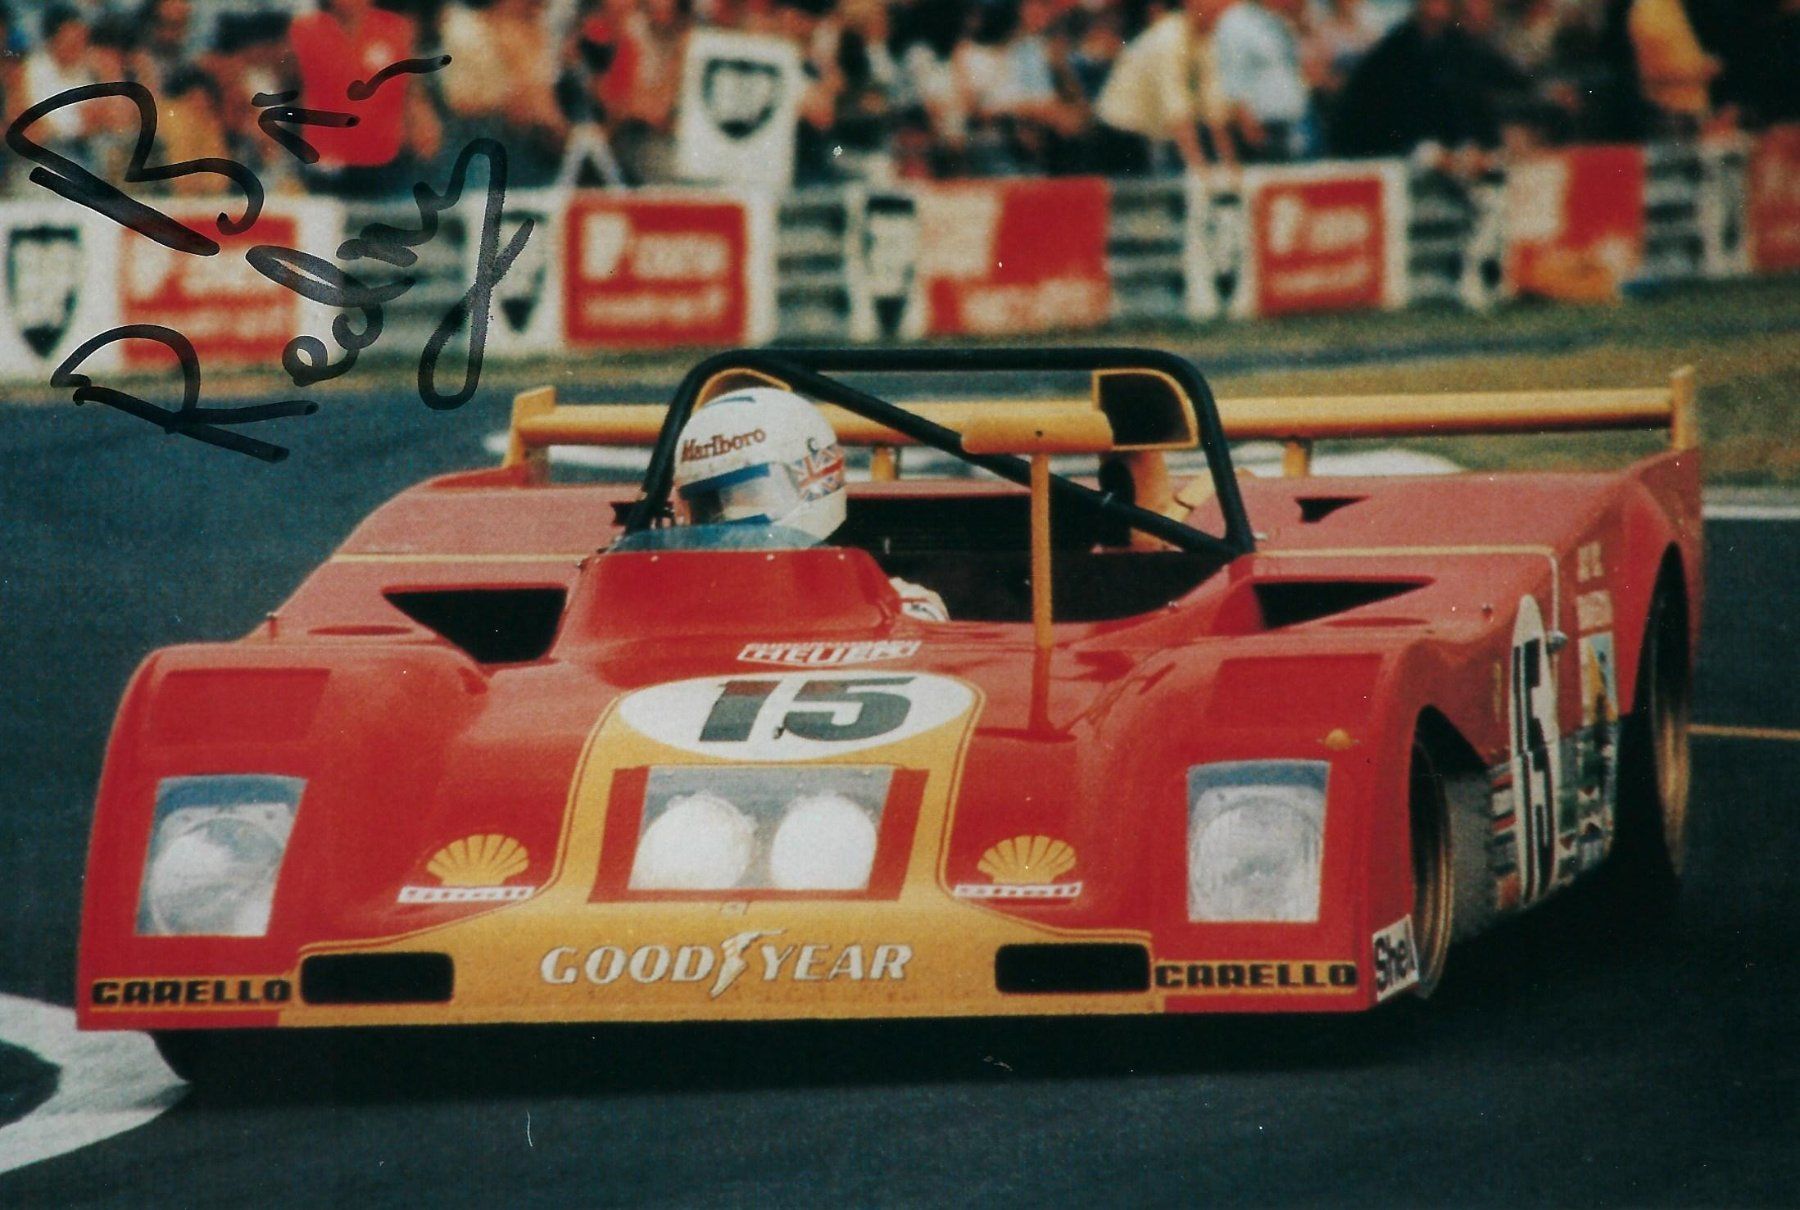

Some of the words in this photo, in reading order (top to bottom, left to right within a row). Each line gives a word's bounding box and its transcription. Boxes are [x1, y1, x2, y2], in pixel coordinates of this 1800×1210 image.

[681, 428, 767, 463] Marlboro
[699, 677, 916, 742] 15
[1155, 963, 1358, 988] CARELLO
[92, 979, 291, 1005] CARELLO
